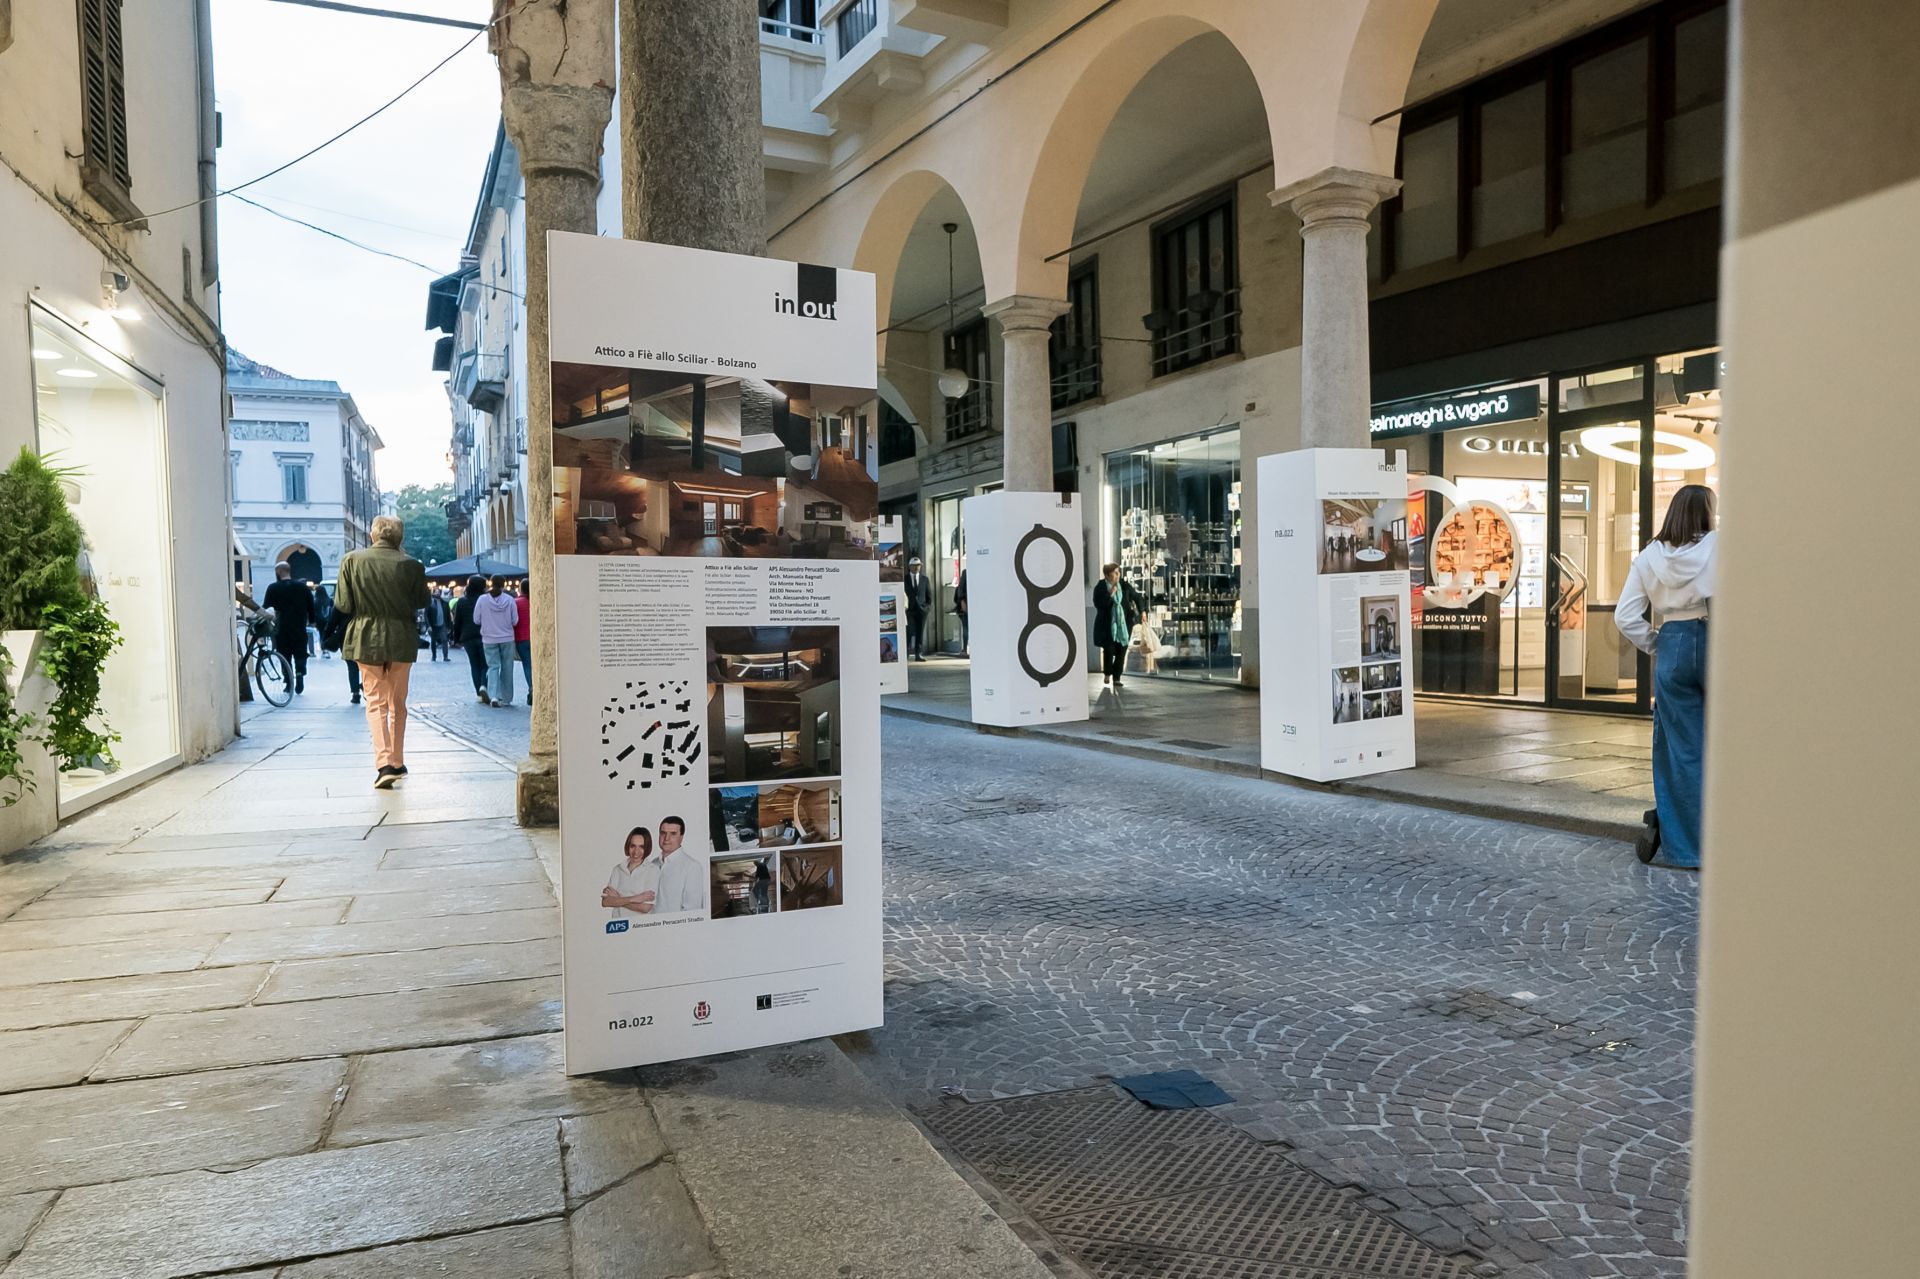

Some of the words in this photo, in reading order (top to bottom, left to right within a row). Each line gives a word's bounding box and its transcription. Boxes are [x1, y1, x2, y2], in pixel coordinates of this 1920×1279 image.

[775, 292, 795, 315] in
[594, 346, 626, 357] Attico
[628, 350, 635, 358] a
[637, 349, 653, 360] Fiè
[655, 351, 675, 362] allo
[677, 353, 708, 365] Sciliar
[717, 357, 757, 369] Bolzano
[1444, 404, 1456, 421] &
[1460, 615, 1488, 623] TUTTO
[608, 922, 627, 932] APS
[632, 921, 662, 929] Alessandro
[609, 1015, 654, 1030] na.022
